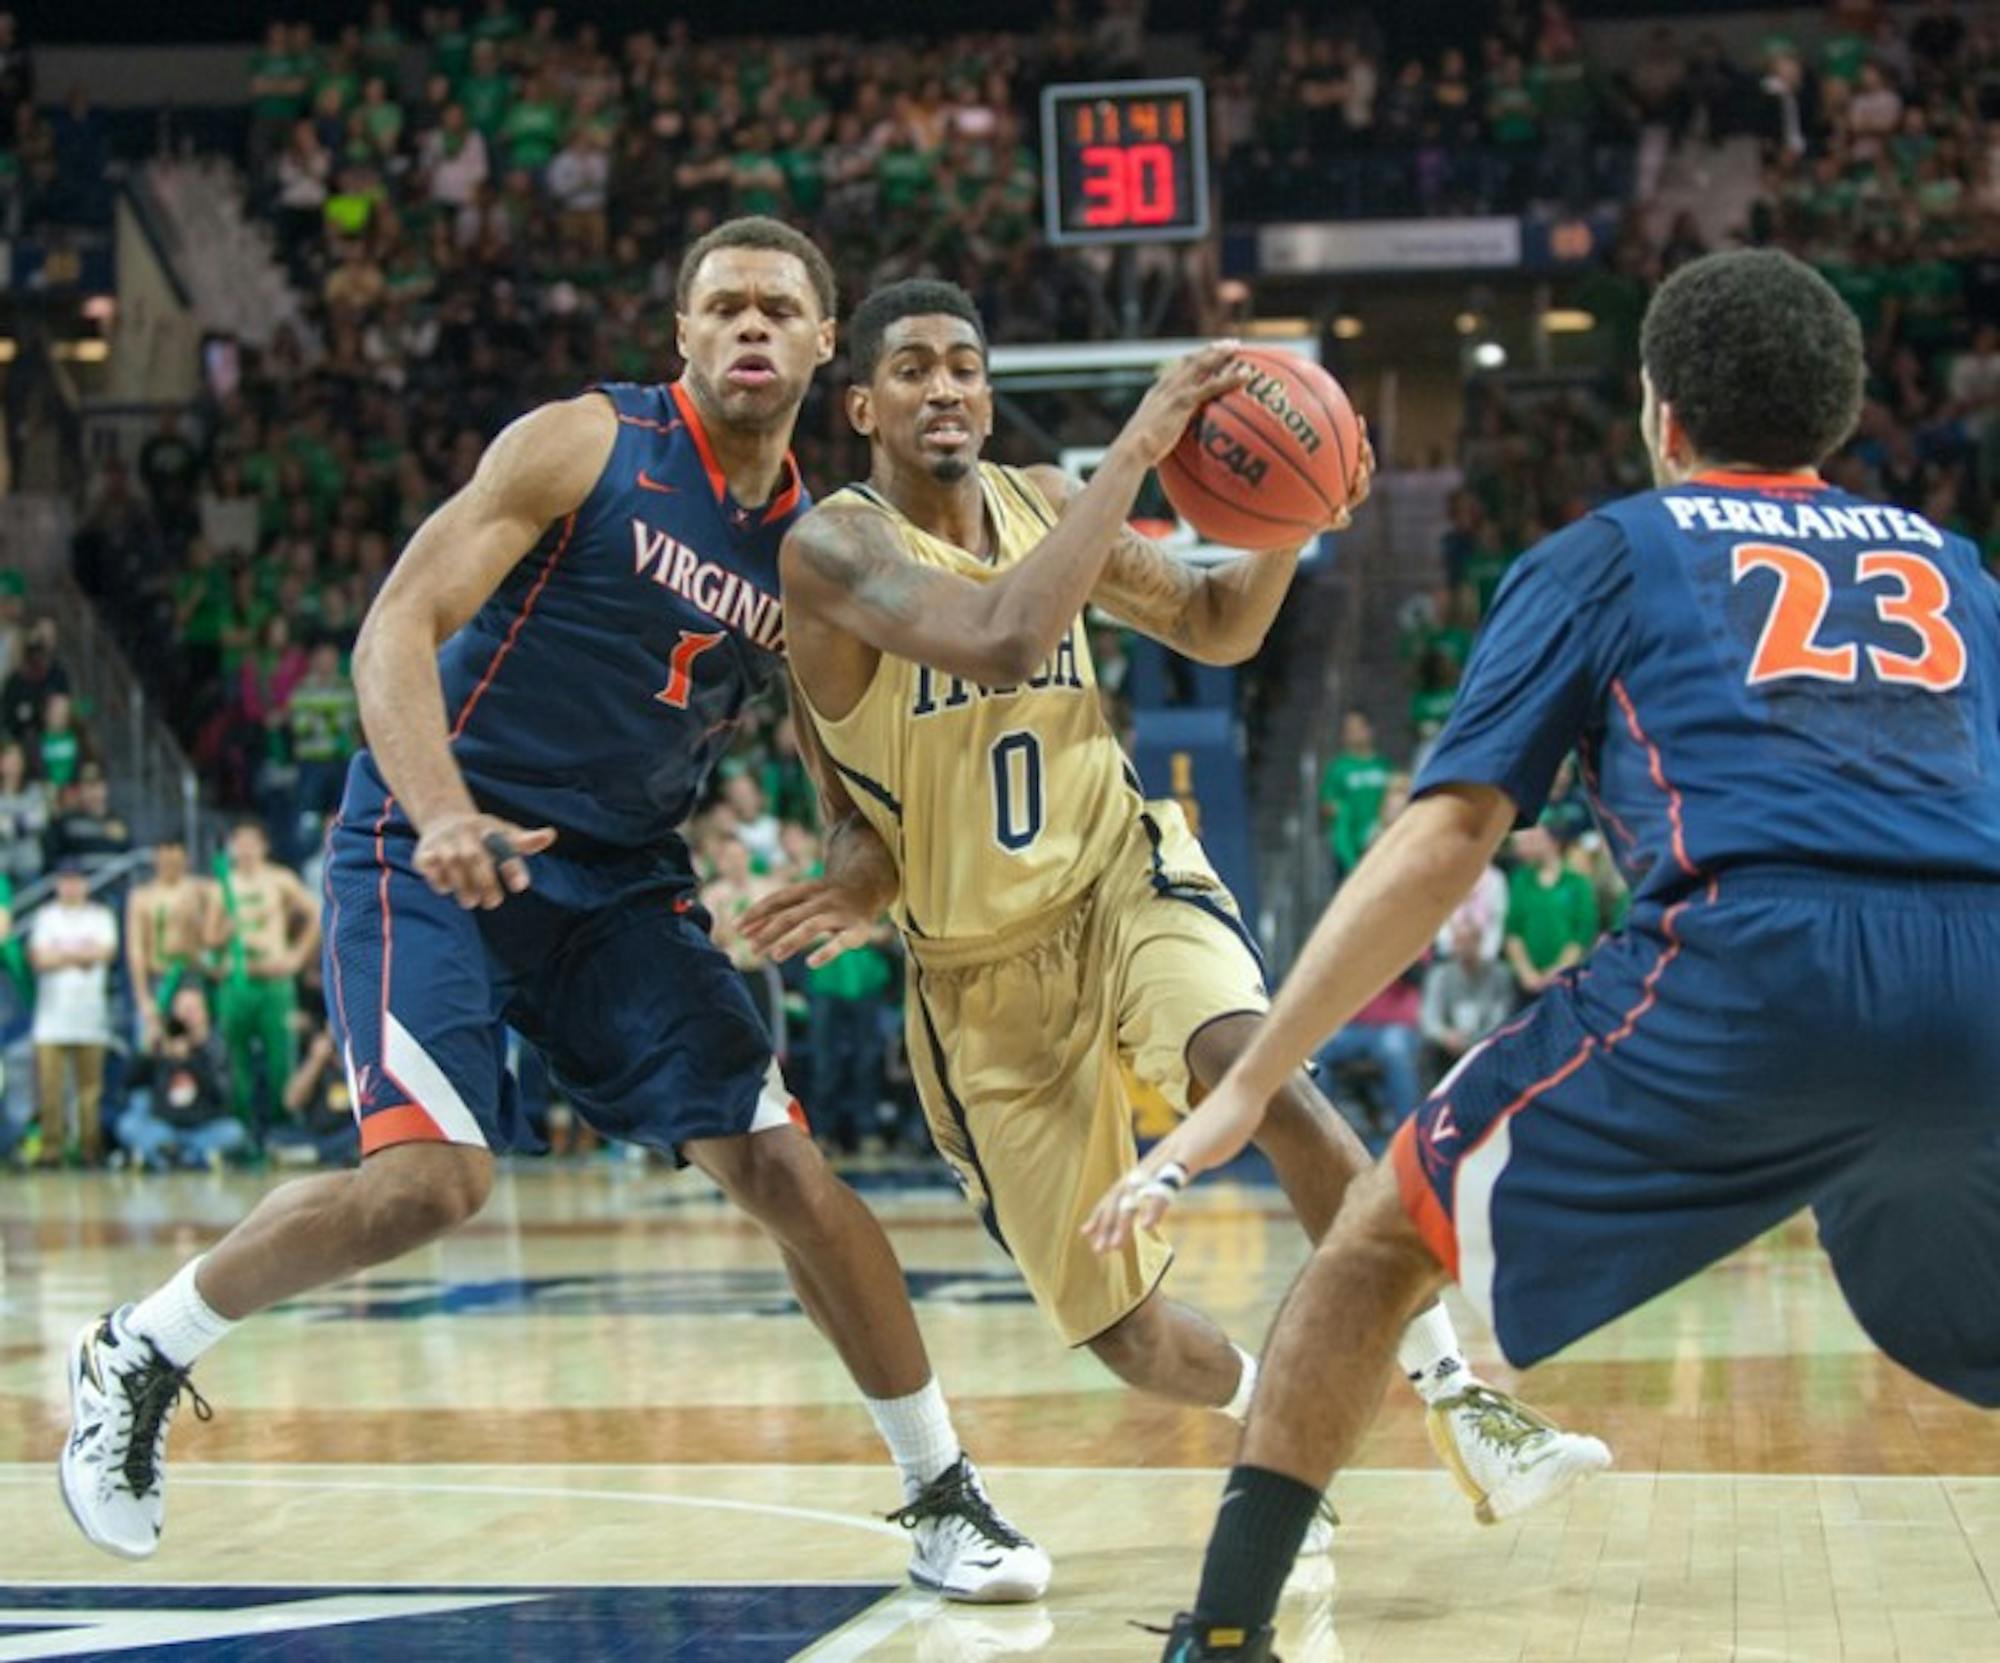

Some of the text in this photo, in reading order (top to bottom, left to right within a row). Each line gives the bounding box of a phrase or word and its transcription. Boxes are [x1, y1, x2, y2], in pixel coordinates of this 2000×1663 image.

[1081, 142, 1176, 226] 30
[1663, 497, 1943, 548] PERRANTES
[1731, 542, 1966, 692] 23
[654, 630, 729, 709] 1
[990, 730, 1044, 854] 0
